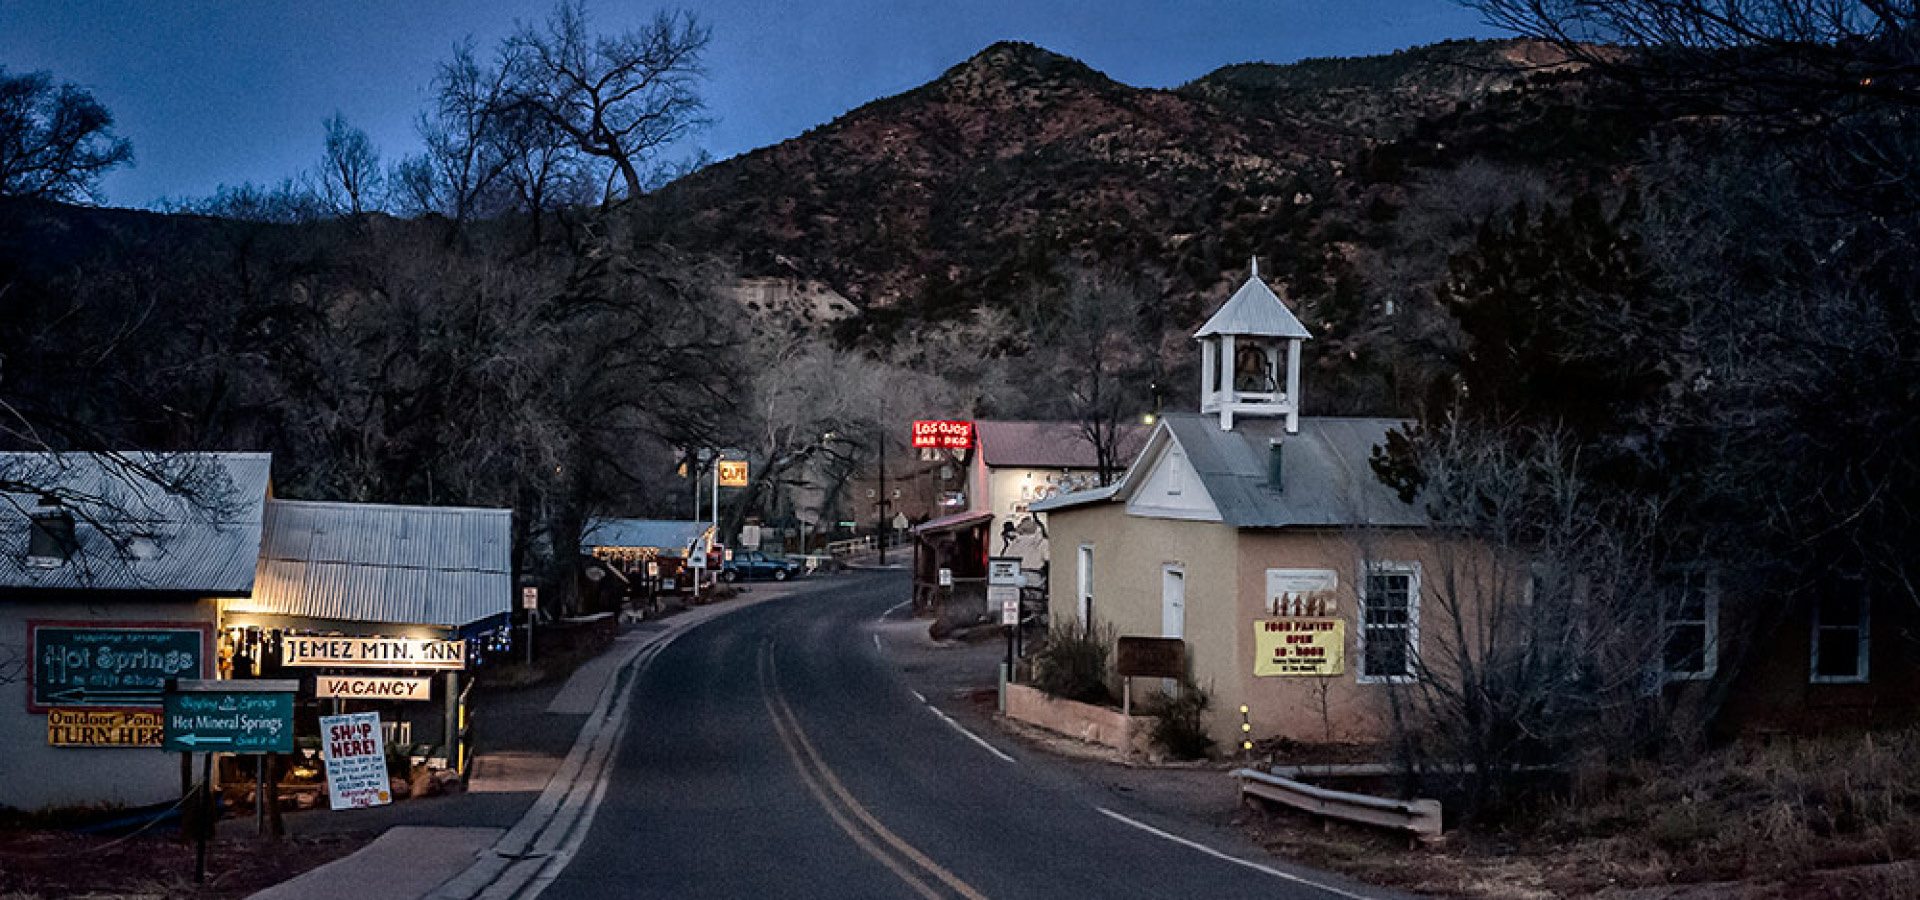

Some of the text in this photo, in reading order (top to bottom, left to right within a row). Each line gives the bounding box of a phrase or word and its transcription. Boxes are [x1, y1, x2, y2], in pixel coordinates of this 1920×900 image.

[916, 422, 968, 436] LOS OJOS
[721, 468, 745, 480] CAFE
[1265, 622, 1335, 632] FOOD PANTRY
[287, 640, 352, 662] JEMEZ
[361, 642, 413, 659] MTN.
[46, 644, 193, 684] Hot Springs
[328, 681, 418, 696] VACANCY
[49, 711, 164, 726] Outdoor Pool
[173, 713, 283, 735] Hot Mineral Springs
[49, 727, 164, 745] TURN HER
[331, 739, 376, 758] HERE!
